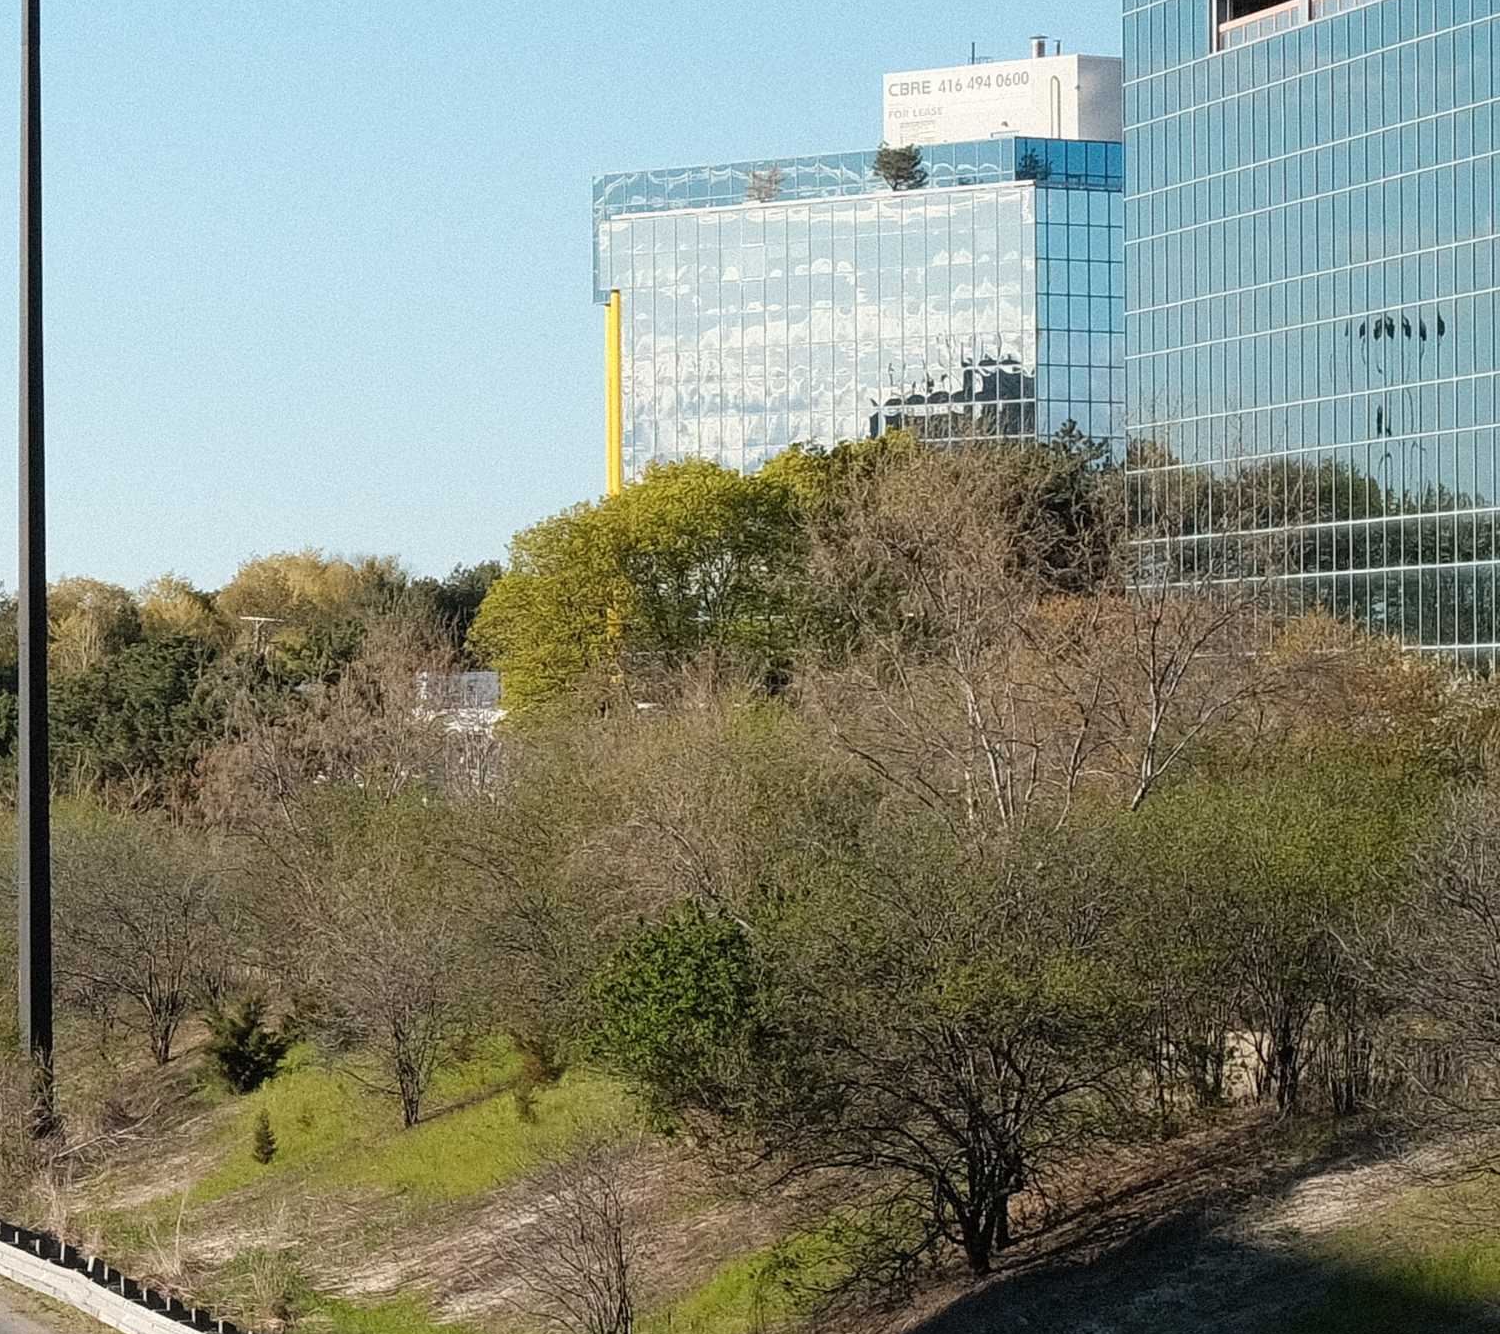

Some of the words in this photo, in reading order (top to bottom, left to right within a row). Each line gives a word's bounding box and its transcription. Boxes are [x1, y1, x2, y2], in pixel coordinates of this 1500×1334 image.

[888, 80, 932, 97] CBRE
[937, 78, 963, 94] 416
[966, 74, 992, 90] 494
[995, 71, 1030, 88] 0600
[888, 109, 909, 119] FOR
[912, 107, 943, 117] LEASE
